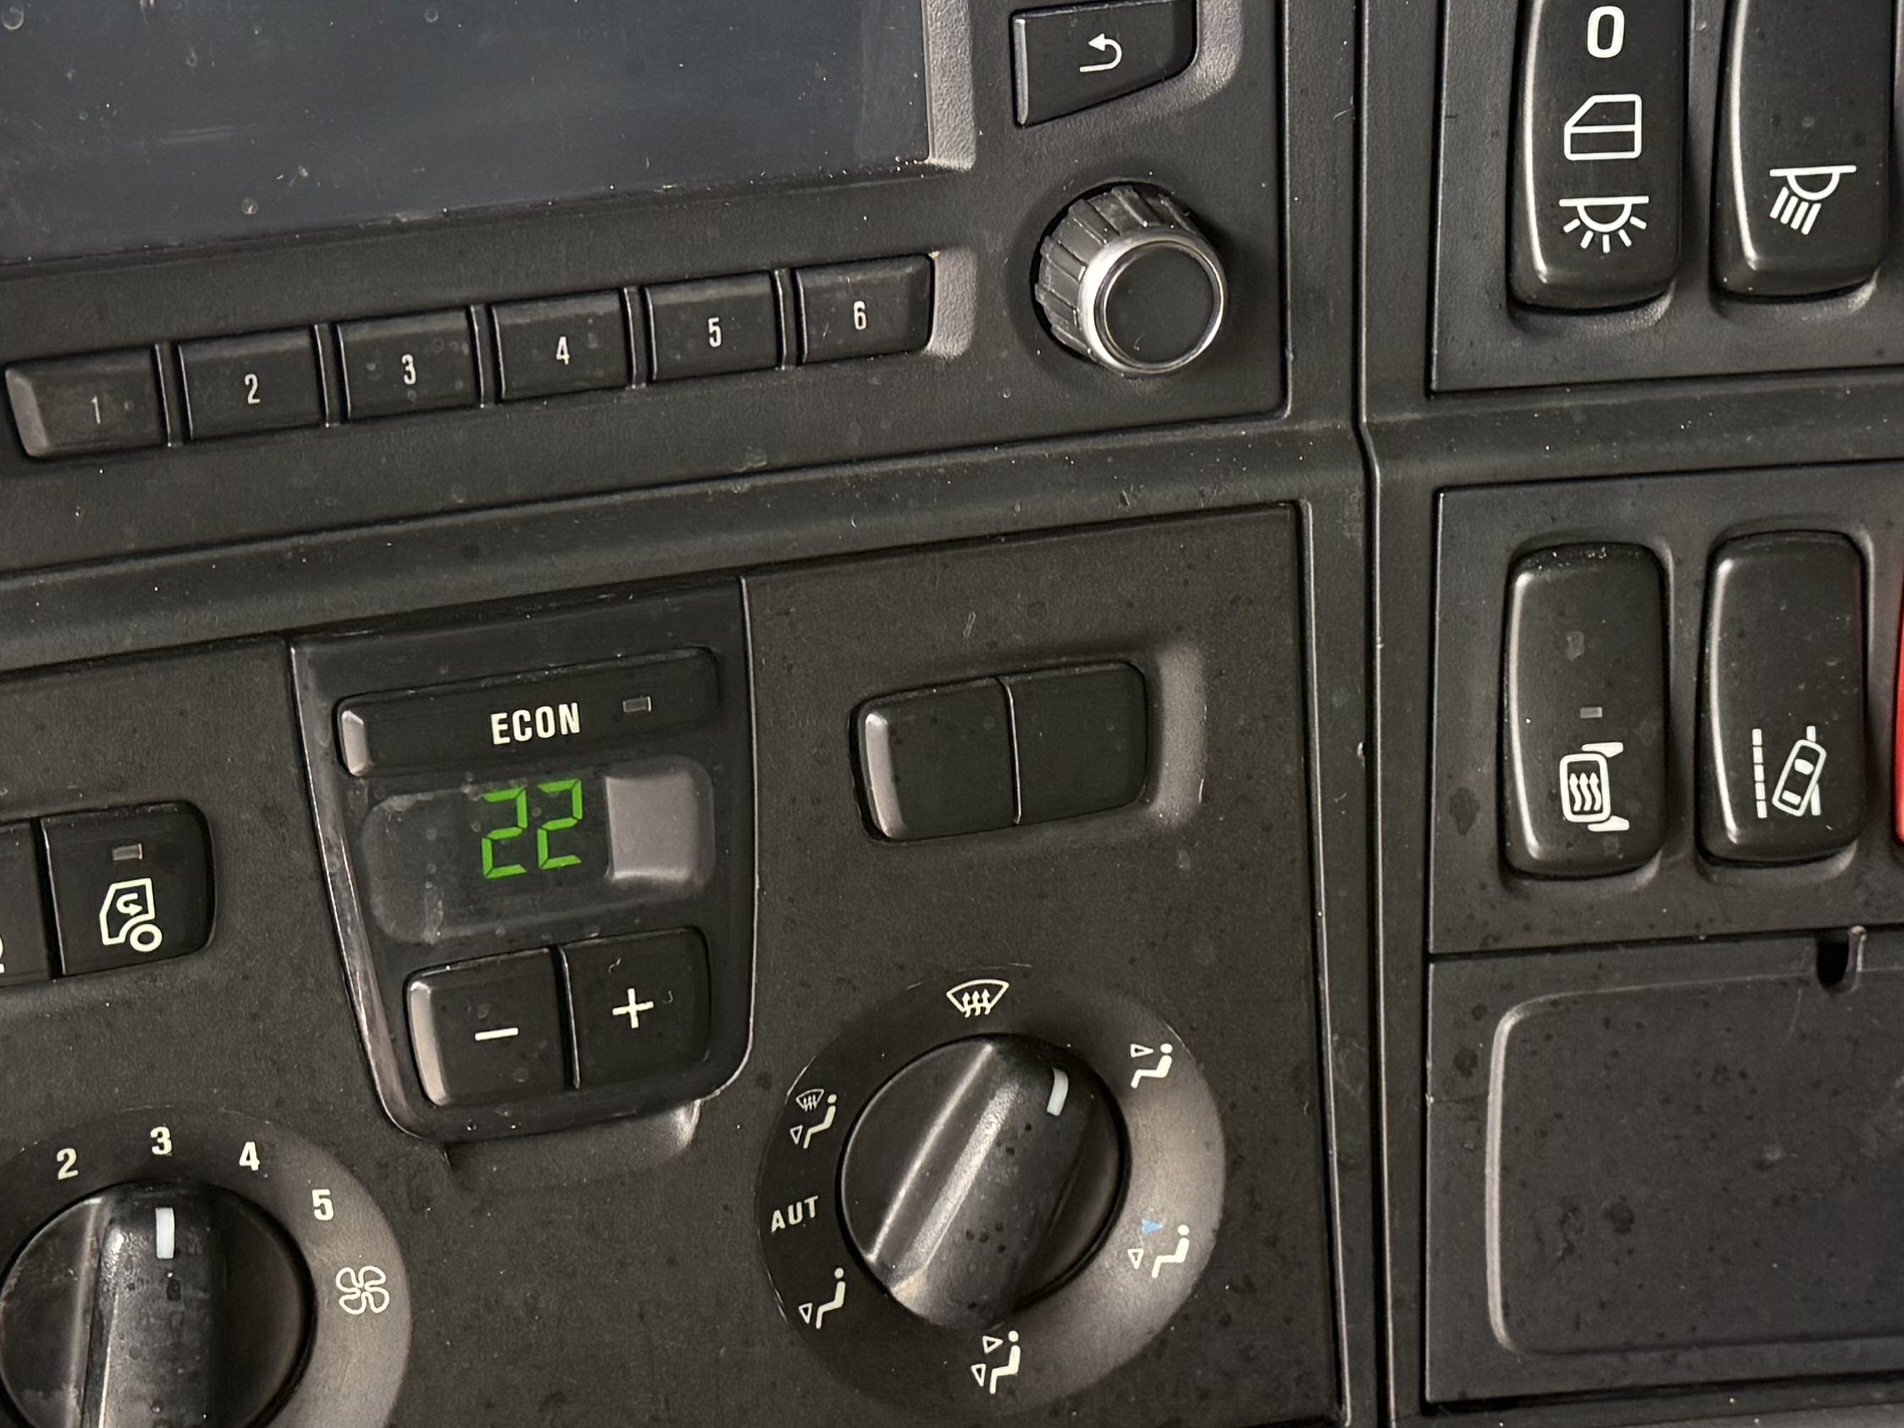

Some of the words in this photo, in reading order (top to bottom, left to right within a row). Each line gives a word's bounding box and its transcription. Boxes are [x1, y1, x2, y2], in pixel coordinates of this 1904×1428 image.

[853, 300, 867, 331] 6
[708, 317, 722, 348] 5
[556, 336, 570, 365] 4
[401, 354, 416, 385] 3
[244, 373, 261, 405] 2
[91, 396, 101, 424] 1
[490, 702, 580, 745] ECON
[481, 778, 583, 879] 22
[149, 1126, 172, 1156] 3
[238, 1141, 261, 1171] 4
[56, 1147, 79, 1180] 2
[311, 1188, 334, 1221] 5
[771, 1195, 819, 1233] AUT
